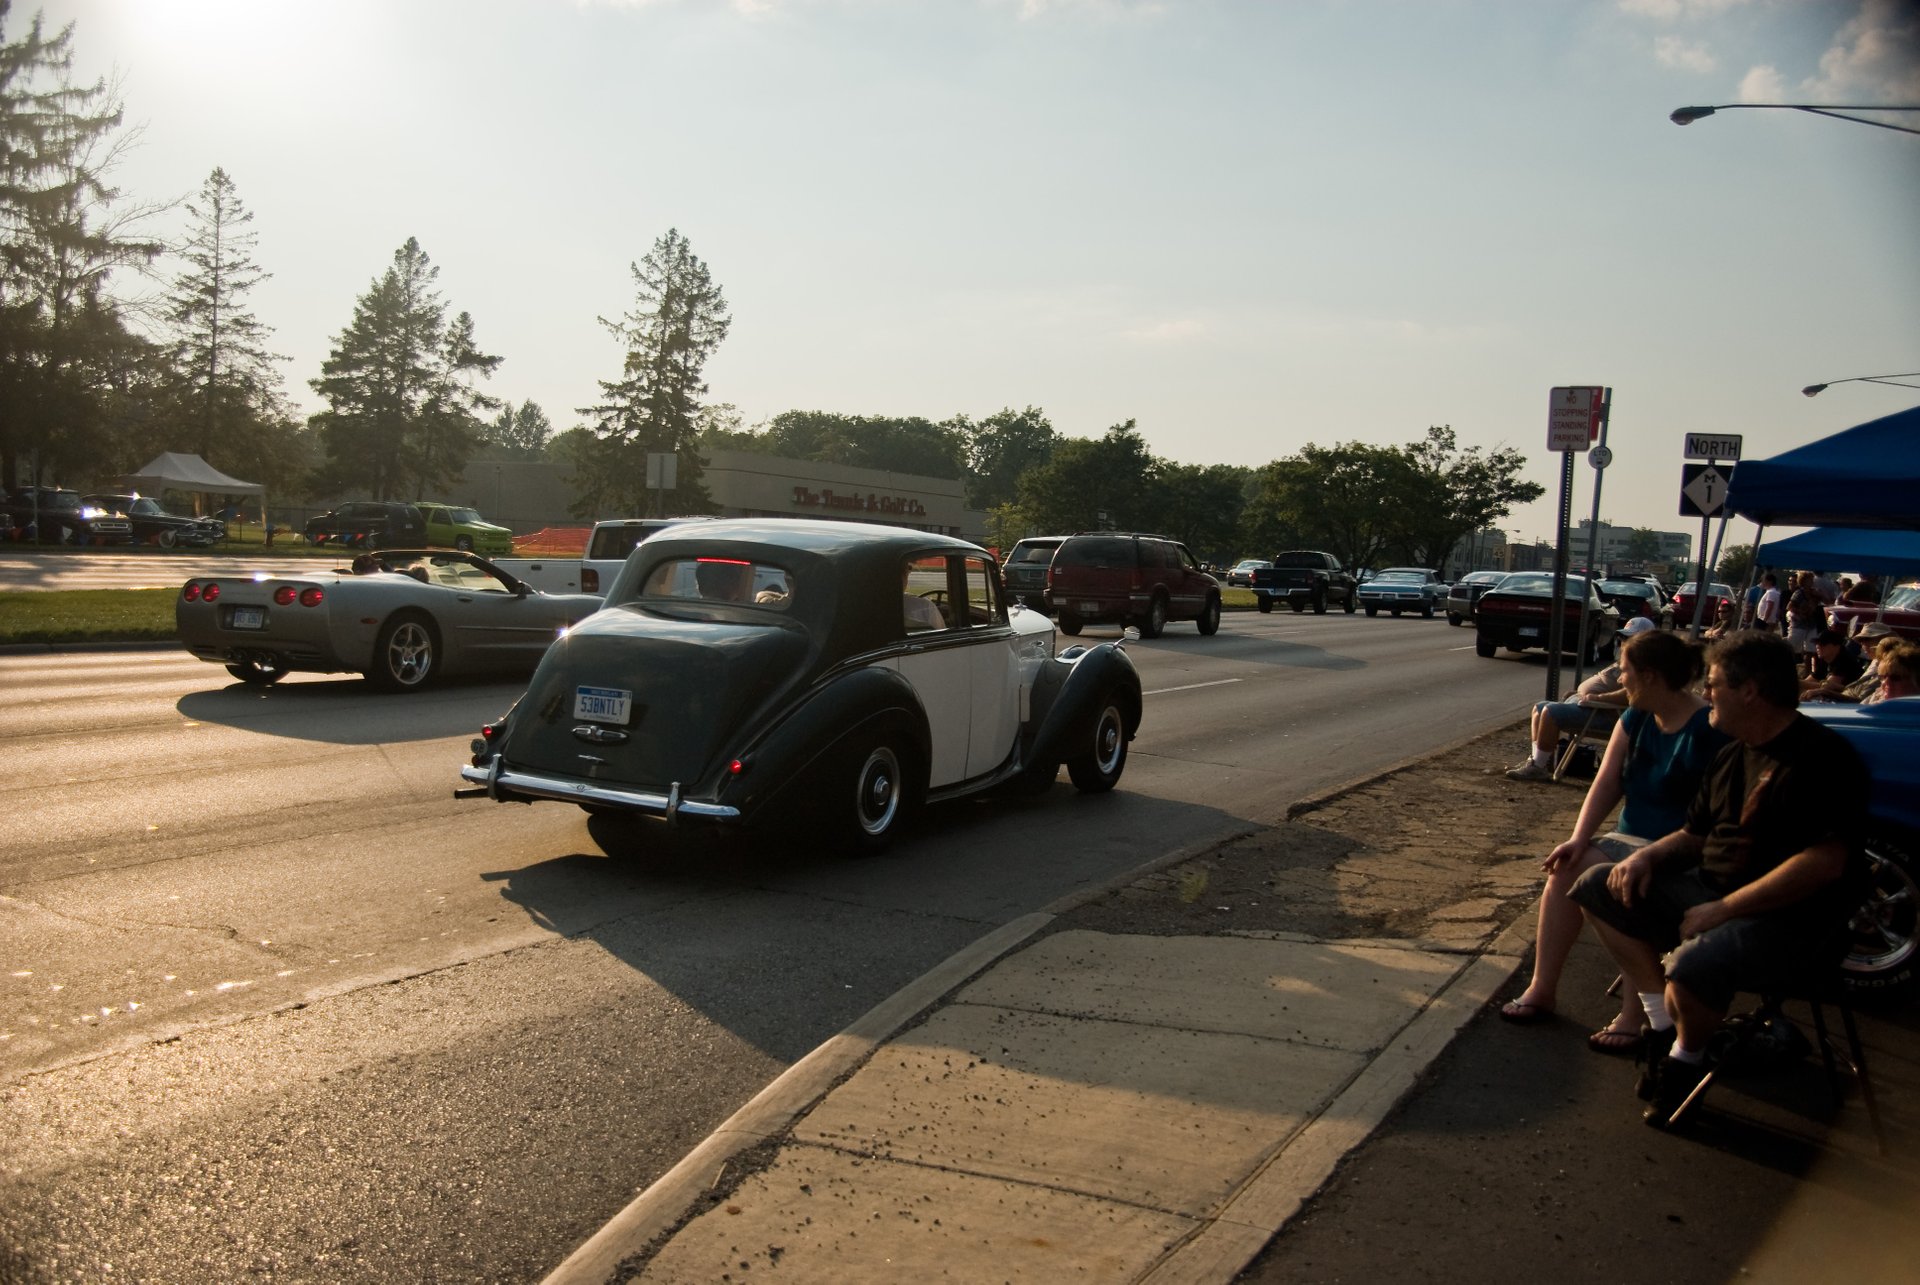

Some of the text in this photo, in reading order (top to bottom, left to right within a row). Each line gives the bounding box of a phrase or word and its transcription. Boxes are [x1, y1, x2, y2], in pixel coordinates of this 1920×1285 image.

[1566, 395, 1577, 404] NO
[1552, 408, 1588, 417] STOPPING
[1552, 421, 1588, 430] STANDING
[1553, 433, 1584, 443] PARKING
[1688, 438, 1738, 456] NORTH
[1704, 474, 1716, 483] M
[1705, 485, 1712, 504] 1
[793, 486, 819, 506] The
[822, 489, 865, 512] Tennis
[867, 493, 878, 512] &
[880, 496, 907, 515] Golf
[580, 696, 625, 716] 53BNTLY
